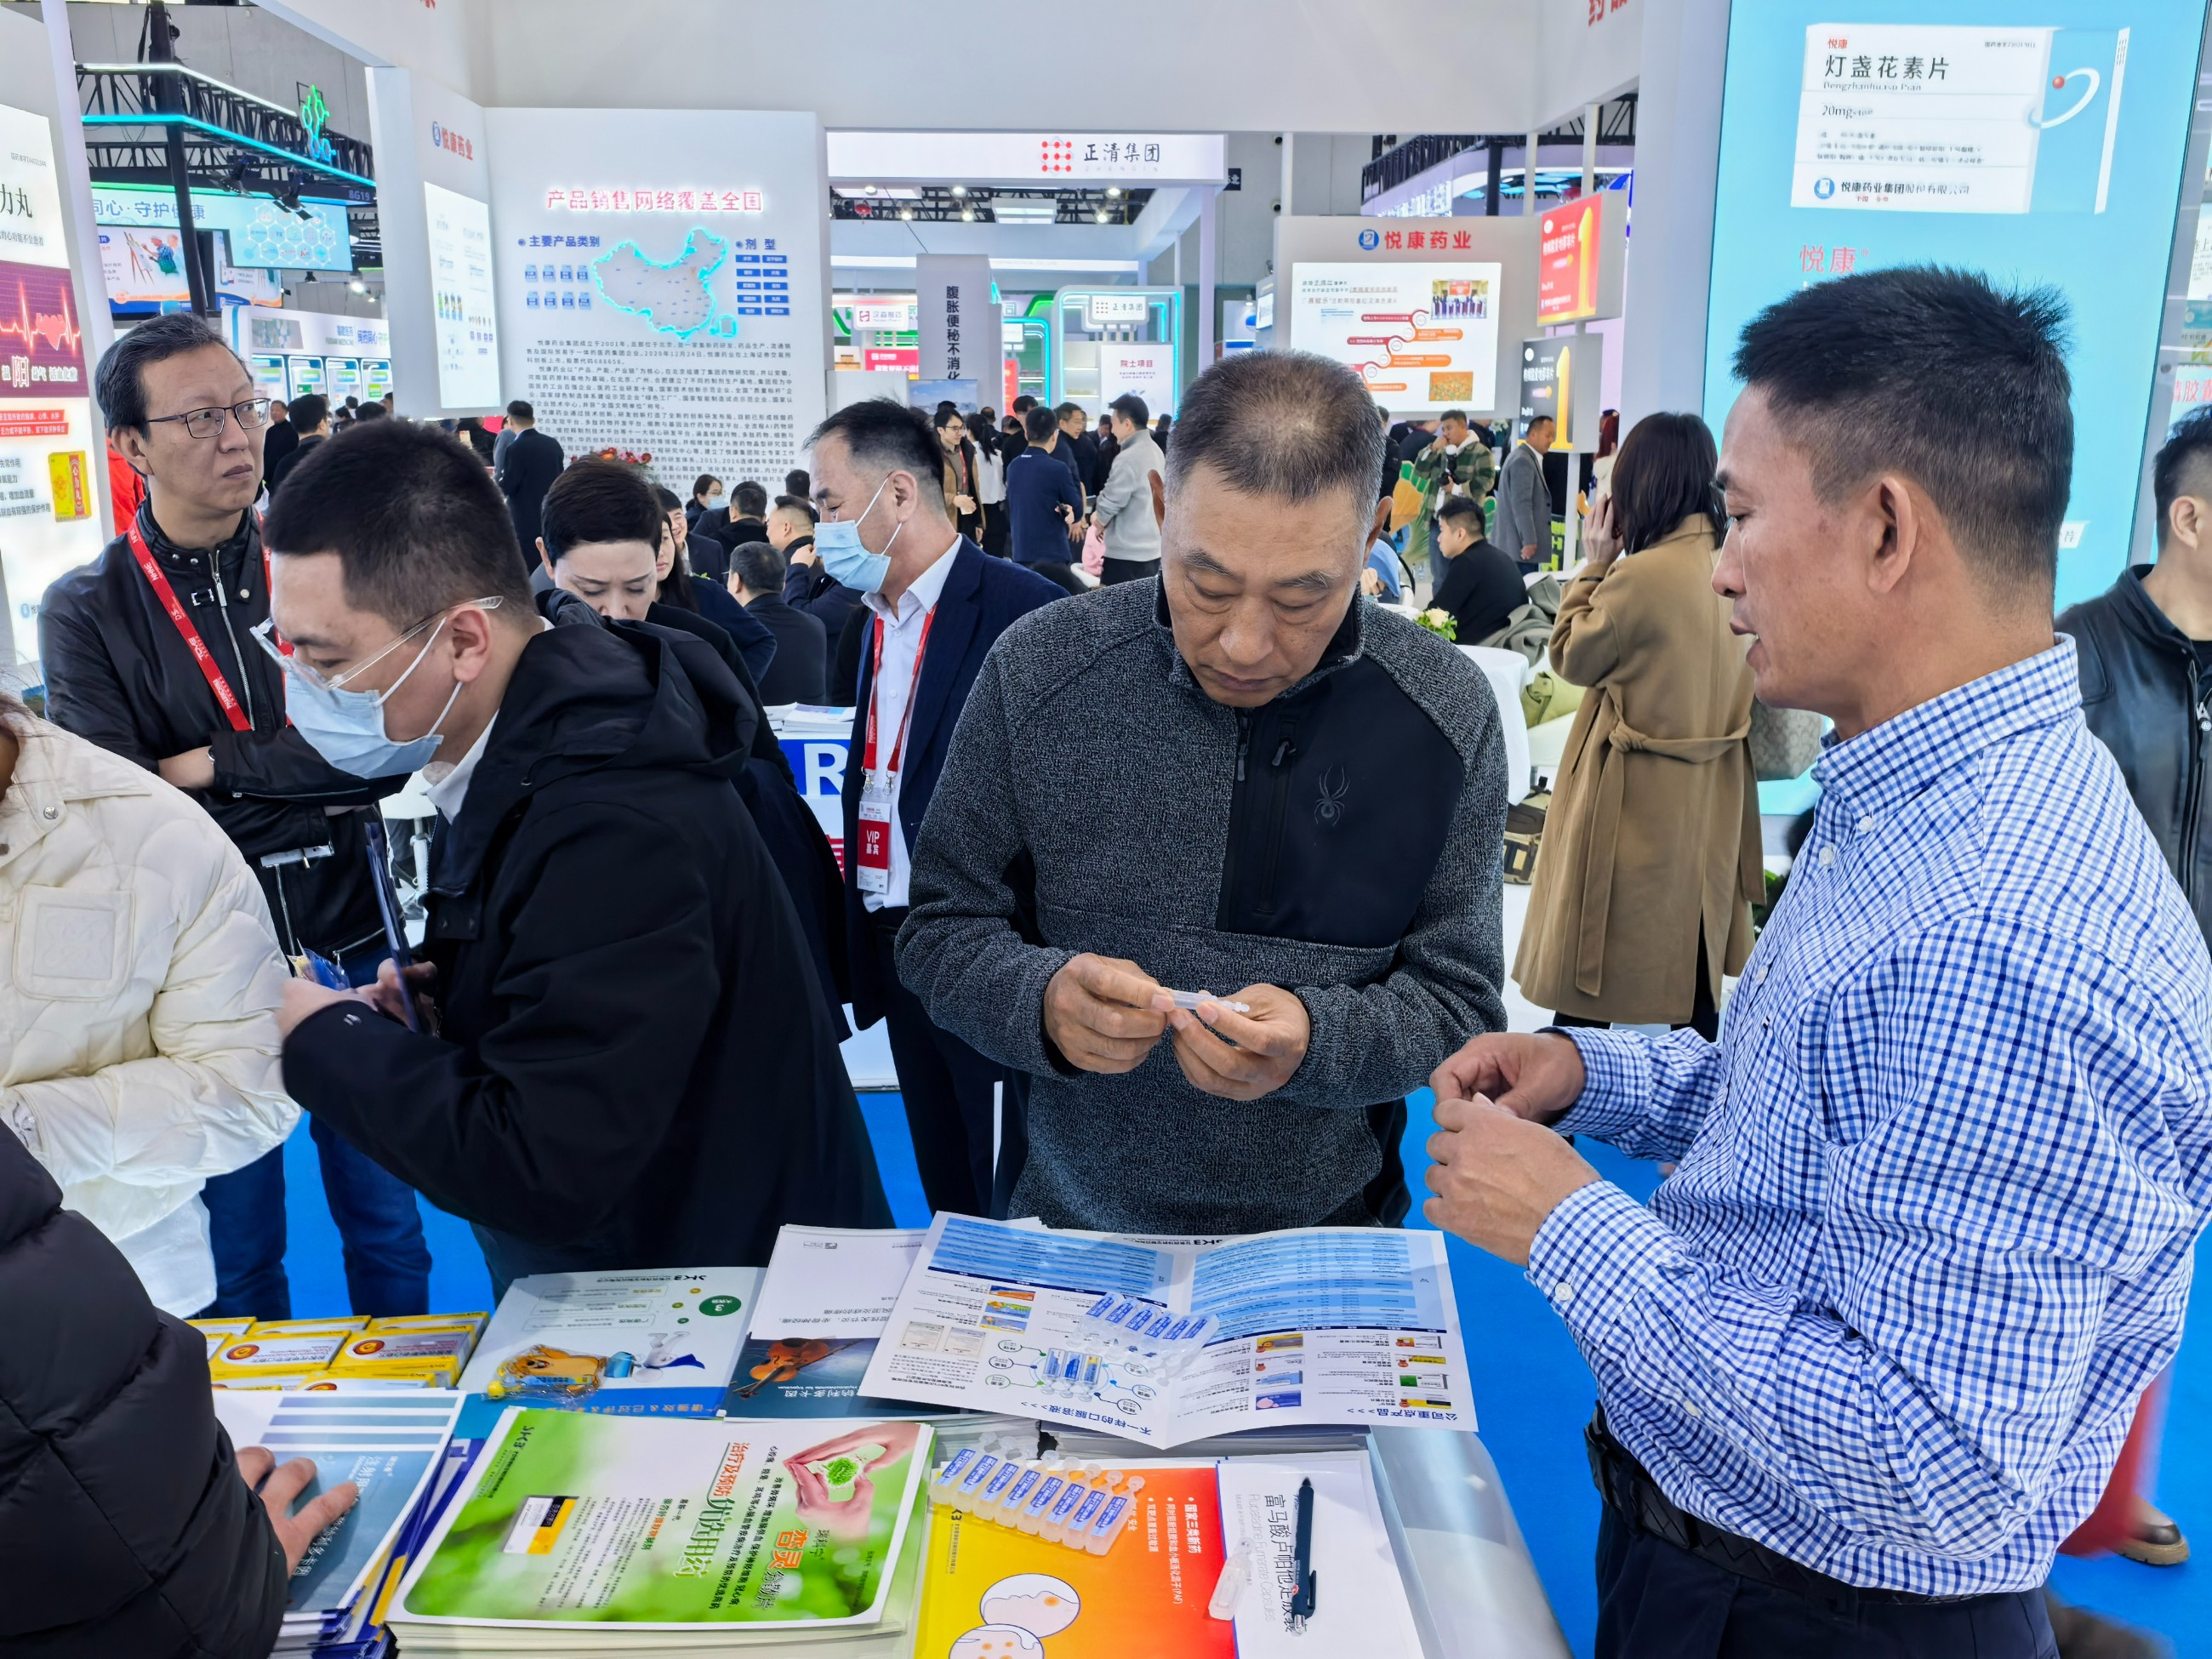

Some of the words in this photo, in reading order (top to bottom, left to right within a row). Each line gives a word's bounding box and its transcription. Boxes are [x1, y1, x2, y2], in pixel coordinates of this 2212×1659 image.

[1827, 39, 1847, 49] 悦康
[1825, 55, 1949, 80] 灯盏花素片
[442, 121, 474, 162] 悦康药业
[1084, 142, 1160, 162] 正清集团
[0, 183, 33, 219] 力丸
[547, 190, 763, 211] 产品销售网络覆盖全国
[0, 231, 44, 247] 的心功能不全患者
[529, 235, 601, 248] 主要产品类别
[1384, 231, 1472, 249] 悦康药业
[946, 285, 960, 380] 腹胀便秘不消化
[71, 465, 83, 501] 心力丸
[803, 743, 850, 796] R
[866, 830, 880, 843] VIP
[1049, 1403, 1152, 1436] 不一样的口服溶液
[1376, 1407, 1458, 1422] 公司重点产品
[712, 1442, 750, 1497] 治疗及预防
[673, 1497, 736, 1578] 优选用药
[1184, 1503, 1201, 1554] 国家三类新药
[767, 1528, 809, 1571] 杏灵
[1254, 1542, 1271, 1581] Fumarate
[751, 1570, 787, 1610] 分散片
[1260, 1581, 1275, 1622] Capsules
